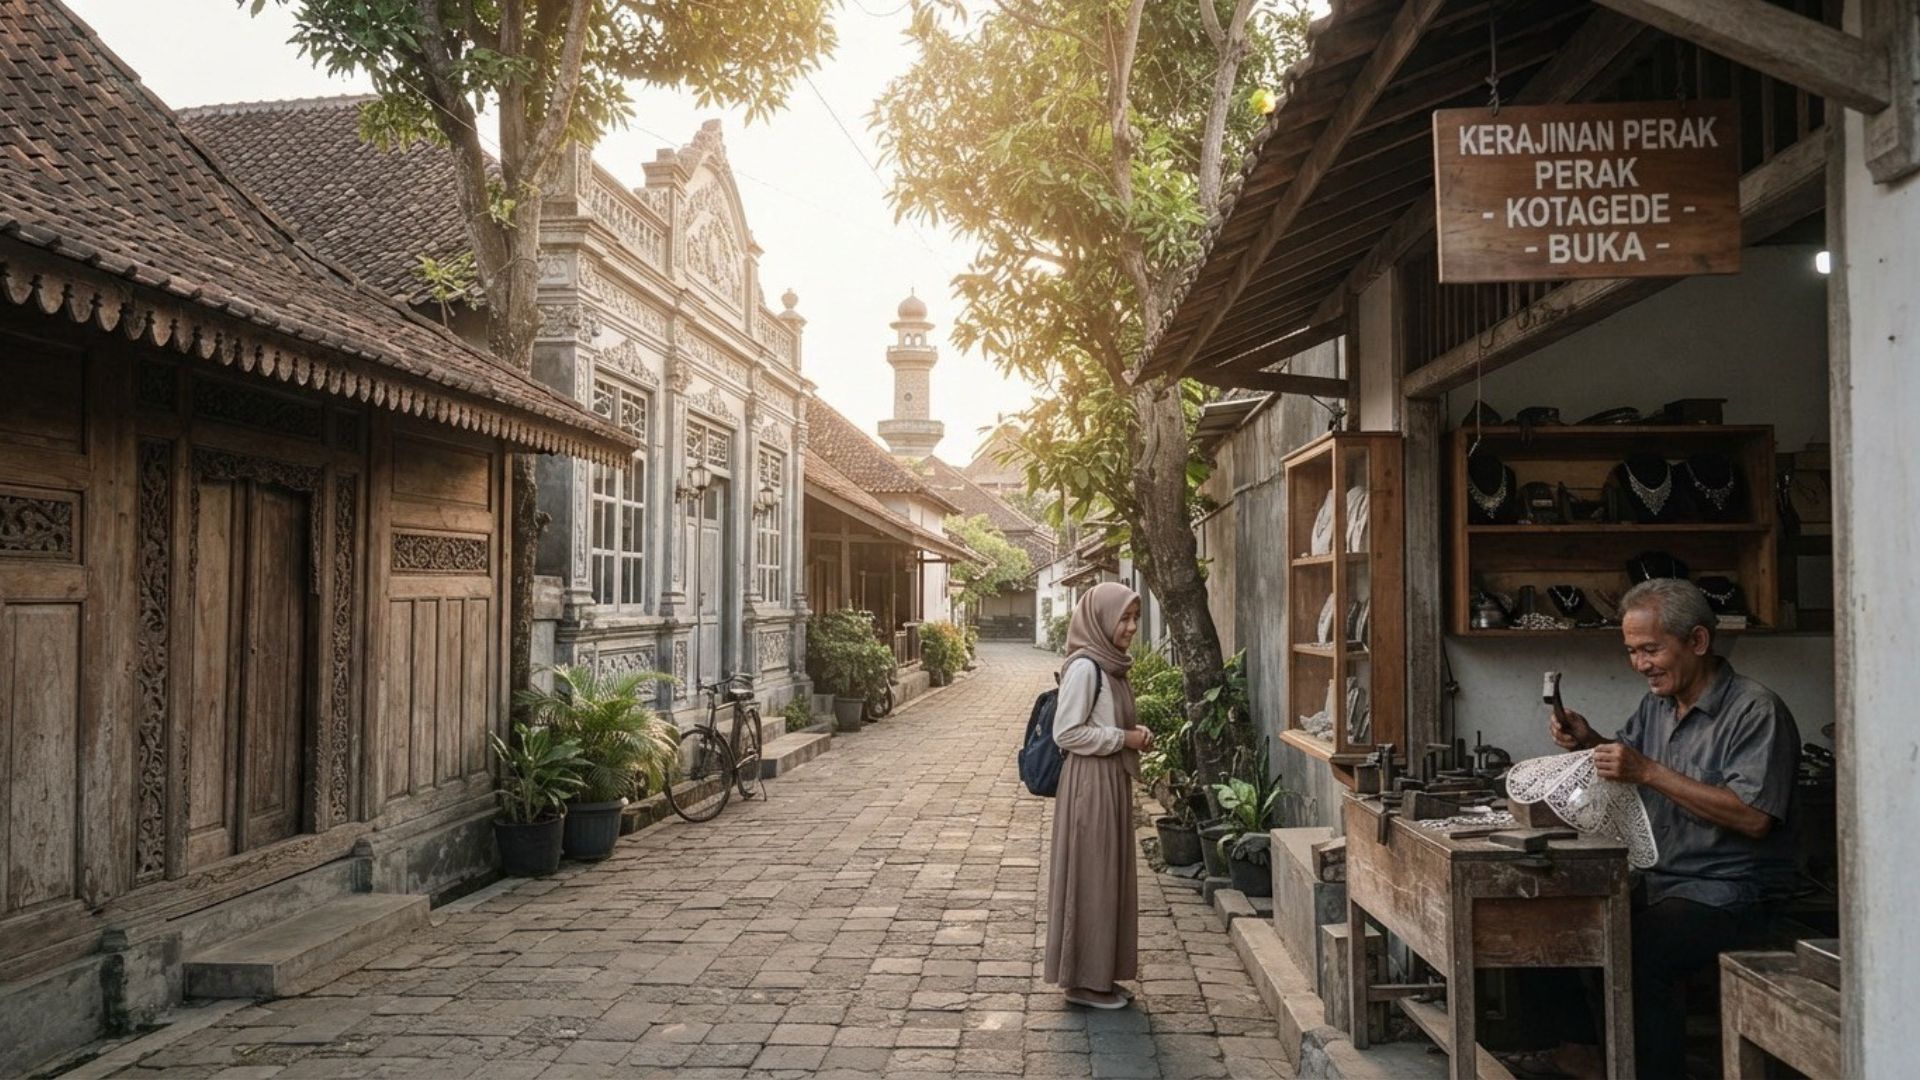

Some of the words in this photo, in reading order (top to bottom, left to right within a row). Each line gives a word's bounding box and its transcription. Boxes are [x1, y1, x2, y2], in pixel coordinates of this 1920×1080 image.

[1459, 119, 1614, 156] KERAJINAN
[1623, 116, 1719, 150] PERAK
[1535, 157, 1639, 190] PERAK
[1506, 193, 1671, 228] KOTAGEDE
[1549, 231, 1647, 263] BUKA
